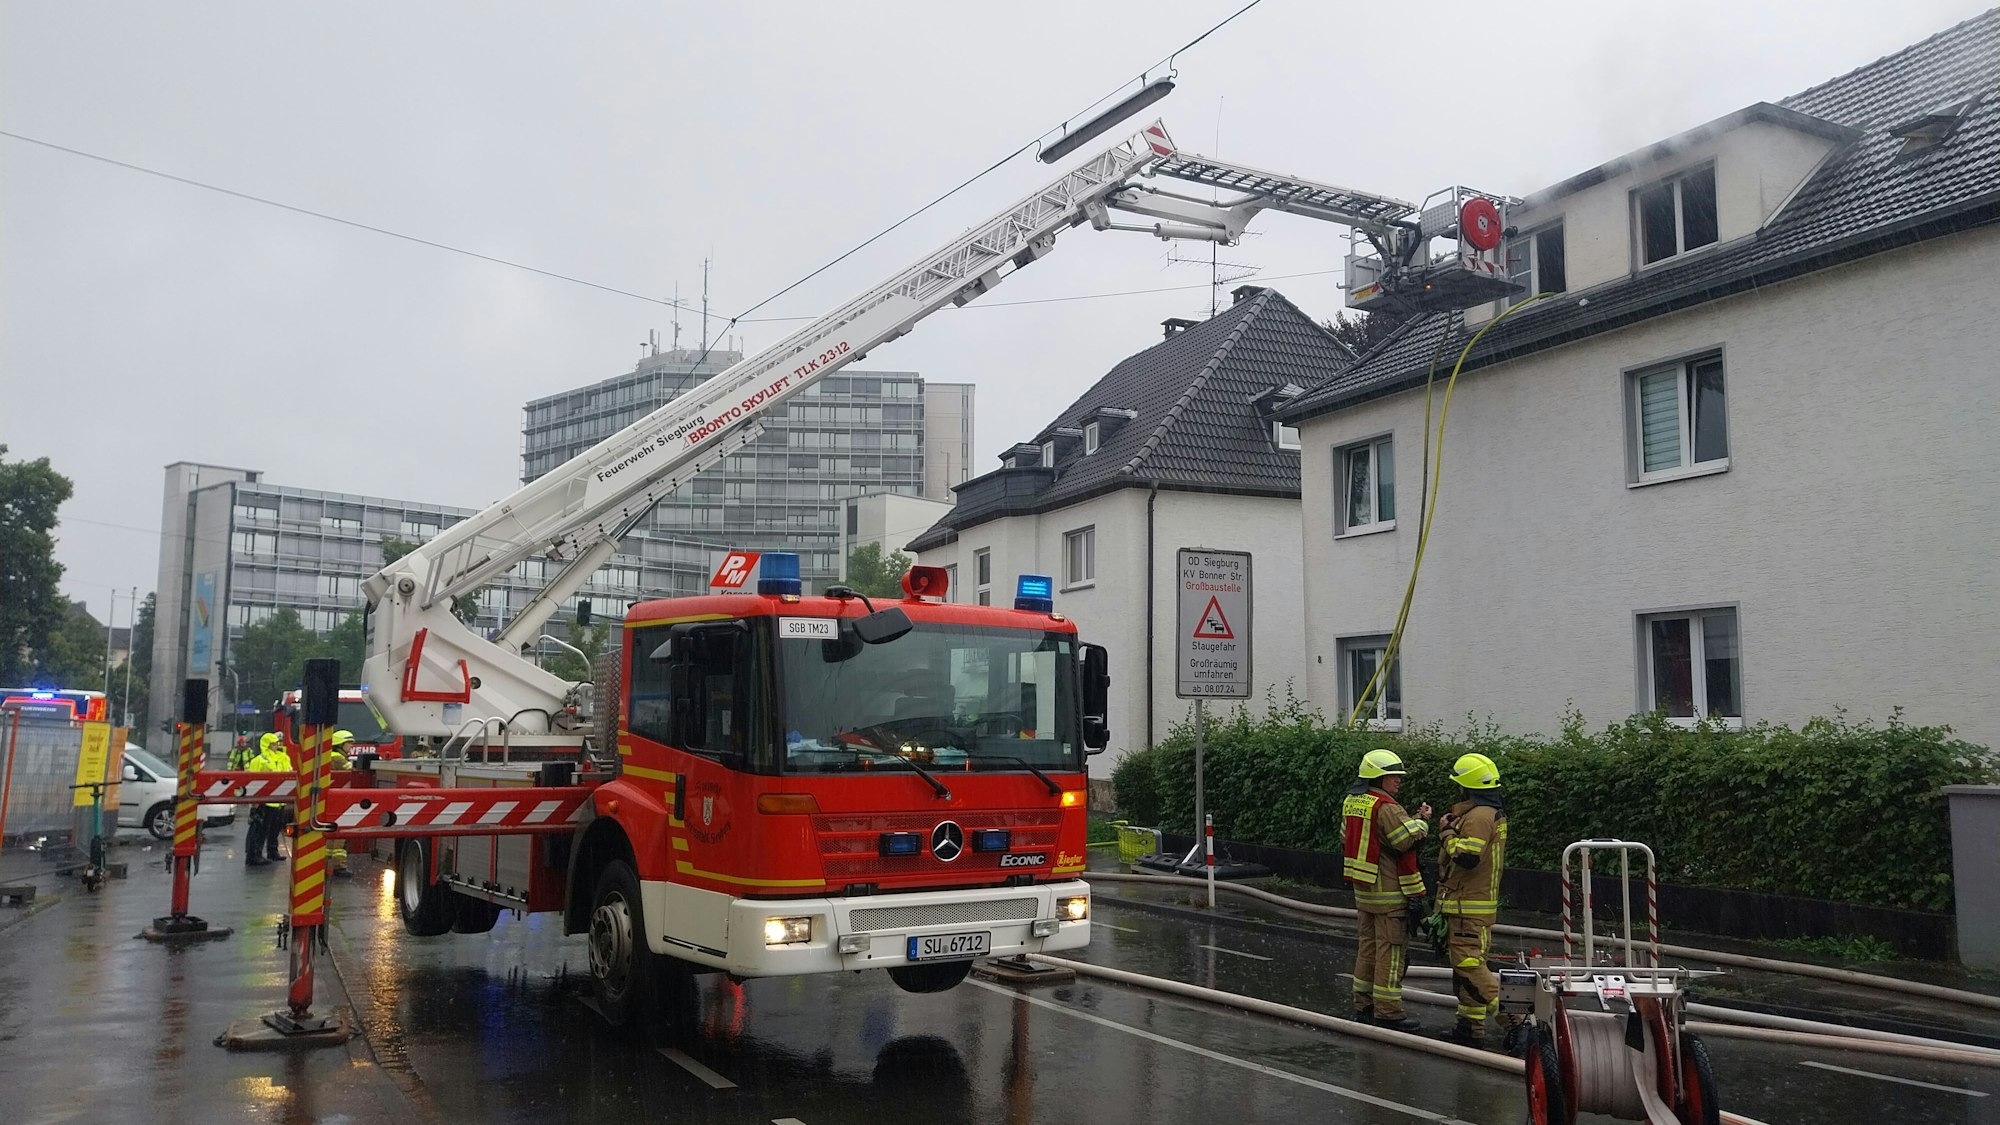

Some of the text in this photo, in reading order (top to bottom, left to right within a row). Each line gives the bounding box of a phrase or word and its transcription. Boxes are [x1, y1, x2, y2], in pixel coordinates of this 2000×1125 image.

[688, 406, 742, 444] BRONTO
[741, 375, 790, 412] SKYLIFT
[794, 359, 820, 380] TLK
[597, 415, 705, 482] Feuerwehr Siegburg
[1188, 556, 1239, 570] OD Siegburg
[1183, 569, 1244, 581] KV Bonner Str.
[1185, 581, 1241, 592] Großbaustelle
[789, 622, 829, 634] SGB TM23
[1192, 641, 1237, 653] Staugefahr
[1190, 658, 1238, 671] Großräumig
[1194, 669, 1234, 679] umfahren
[1192, 684, 1235, 694] ab 08.07.24
[924, 935, 983, 954] SU 6712
